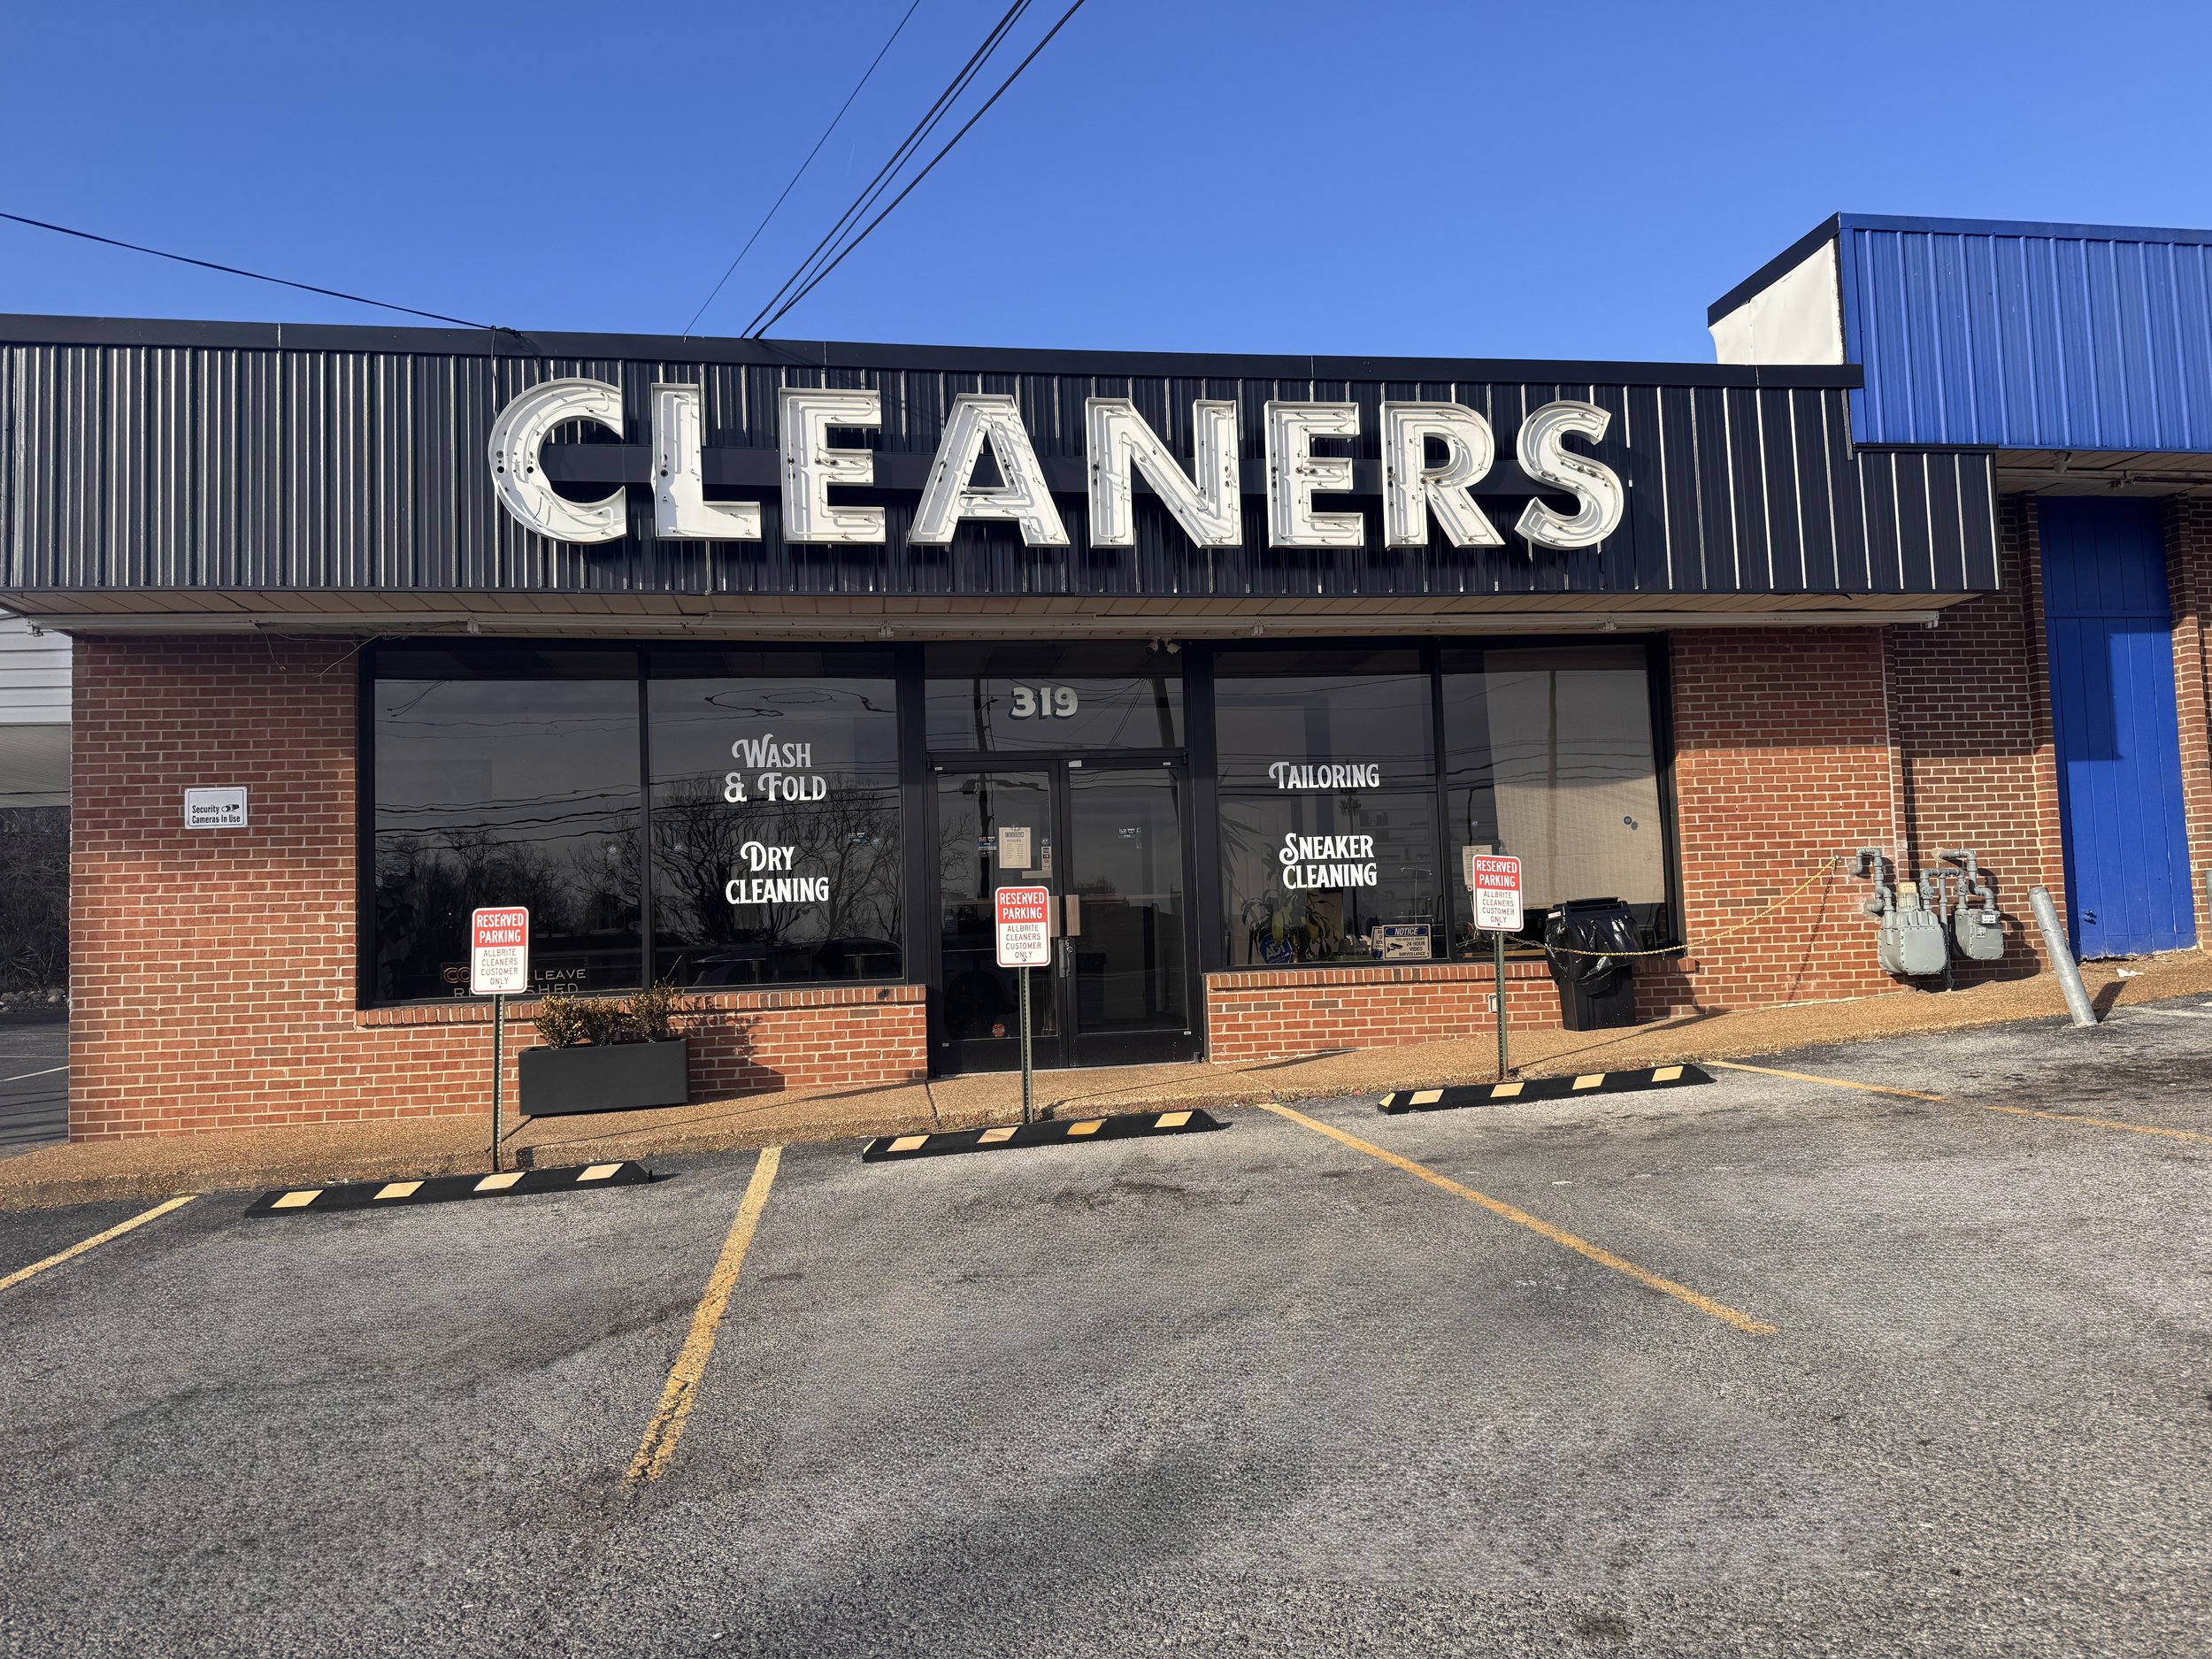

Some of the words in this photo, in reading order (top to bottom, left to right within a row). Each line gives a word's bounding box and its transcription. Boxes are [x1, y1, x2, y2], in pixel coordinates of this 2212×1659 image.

[488, 377, 1626, 550] CLEANERS
[1009, 687, 1079, 719] 319
[732, 733, 812, 768] WASH
[1268, 761, 1380, 789] TAILORING
[724, 772, 748, 803] &
[757, 772, 827, 802] FOLD
[192, 805, 219, 814] Security
[192, 815, 219, 824] Cameras
[228, 814, 241, 823] Use
[1279, 833, 1375, 865] SNEAKER
[740, 841, 795, 872] DRY
[1476, 860, 1517, 873] RESERVED
[1283, 863, 1378, 889] CLEANING
[1479, 874, 1516, 887] PARKING
[725, 877, 829, 904] CLEANING
[999, 892, 1045, 905] RESERVED
[477, 913, 524, 927] RESERVED
[1002, 907, 1043, 919] PARKING
[479, 929, 521, 943] PARKING
[480, 967, 518, 976] CUSTOMER
[534, 969, 587, 981] LEAVE
